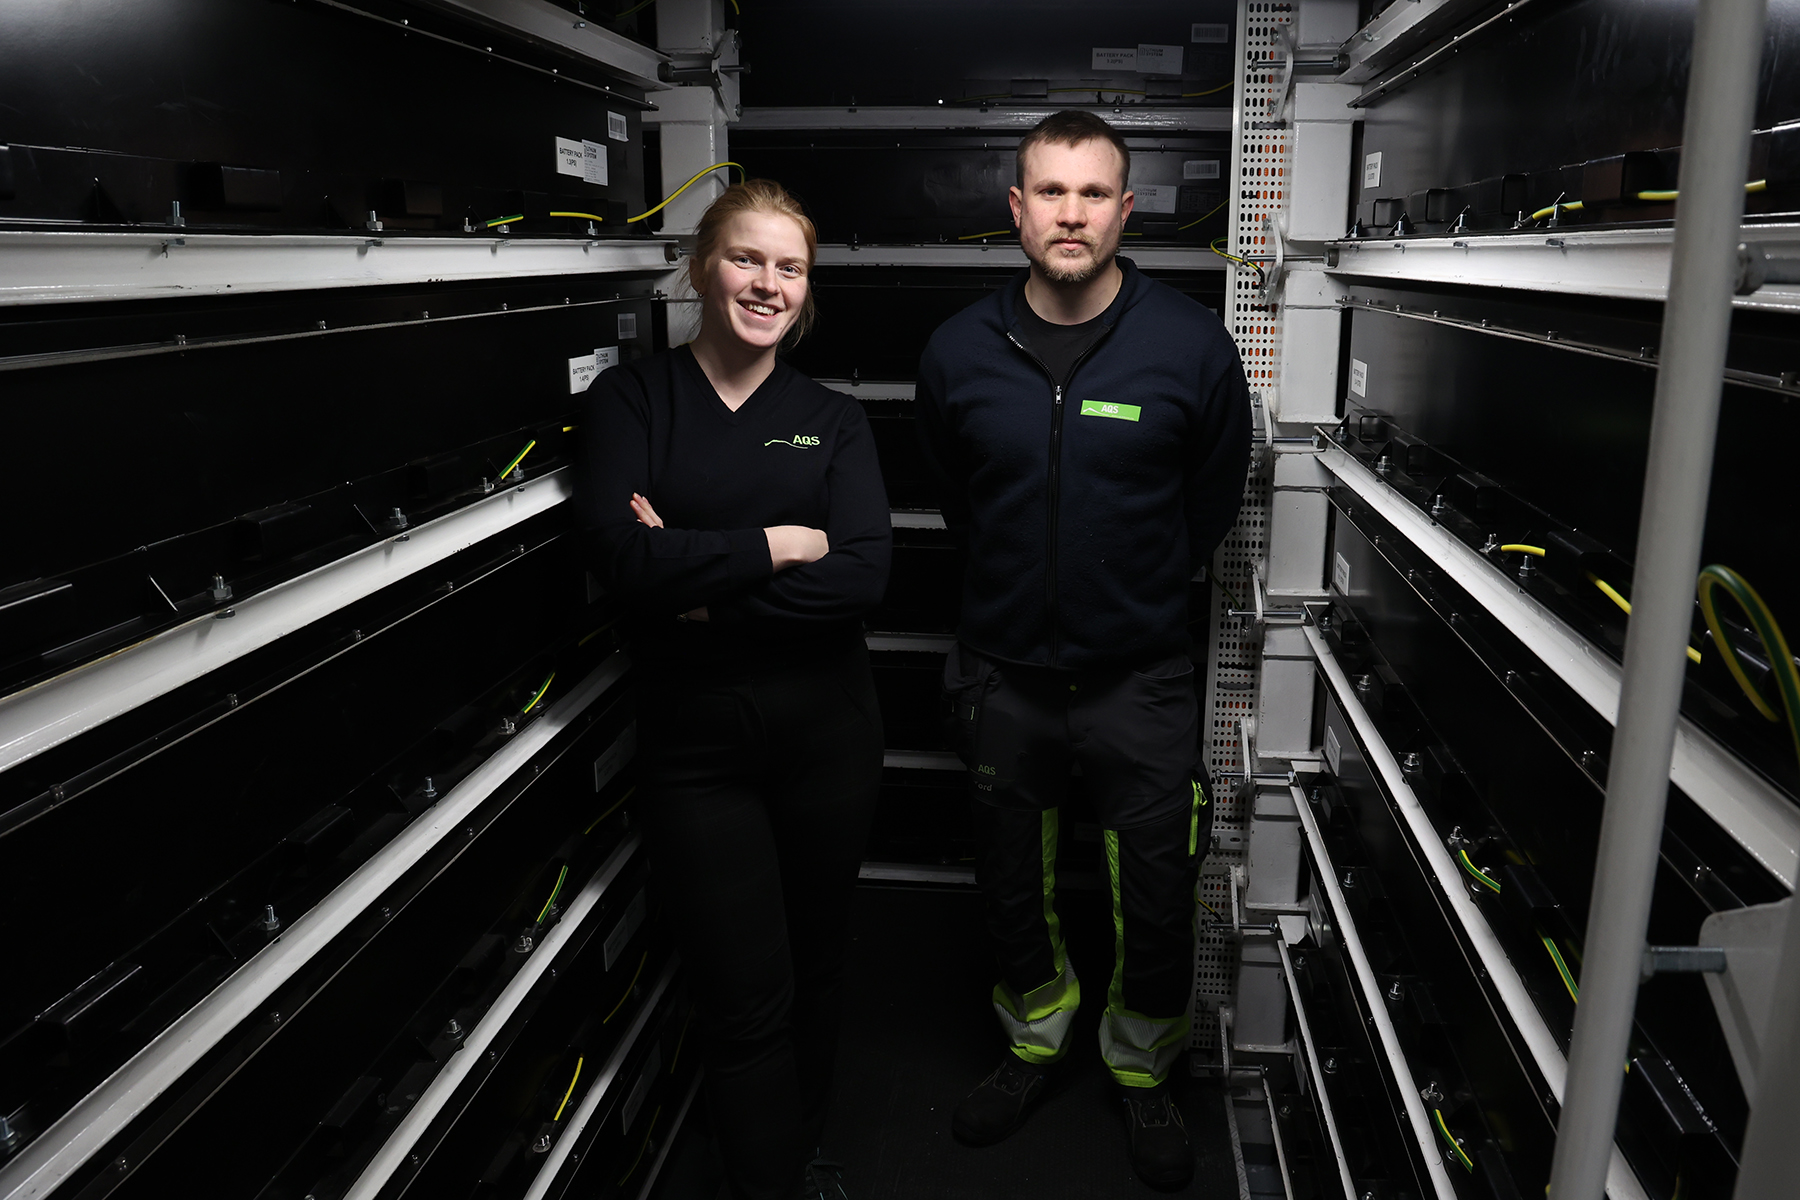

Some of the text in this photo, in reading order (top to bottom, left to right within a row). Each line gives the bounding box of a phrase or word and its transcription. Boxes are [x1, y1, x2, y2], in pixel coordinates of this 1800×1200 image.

[559, 147, 583, 159] BATTERY PACK
[572, 366, 586, 375] BATTERY
[1101, 404, 1119, 414] AQS
[792, 434, 821, 446] AQS
[977, 764, 996, 776] AQS
